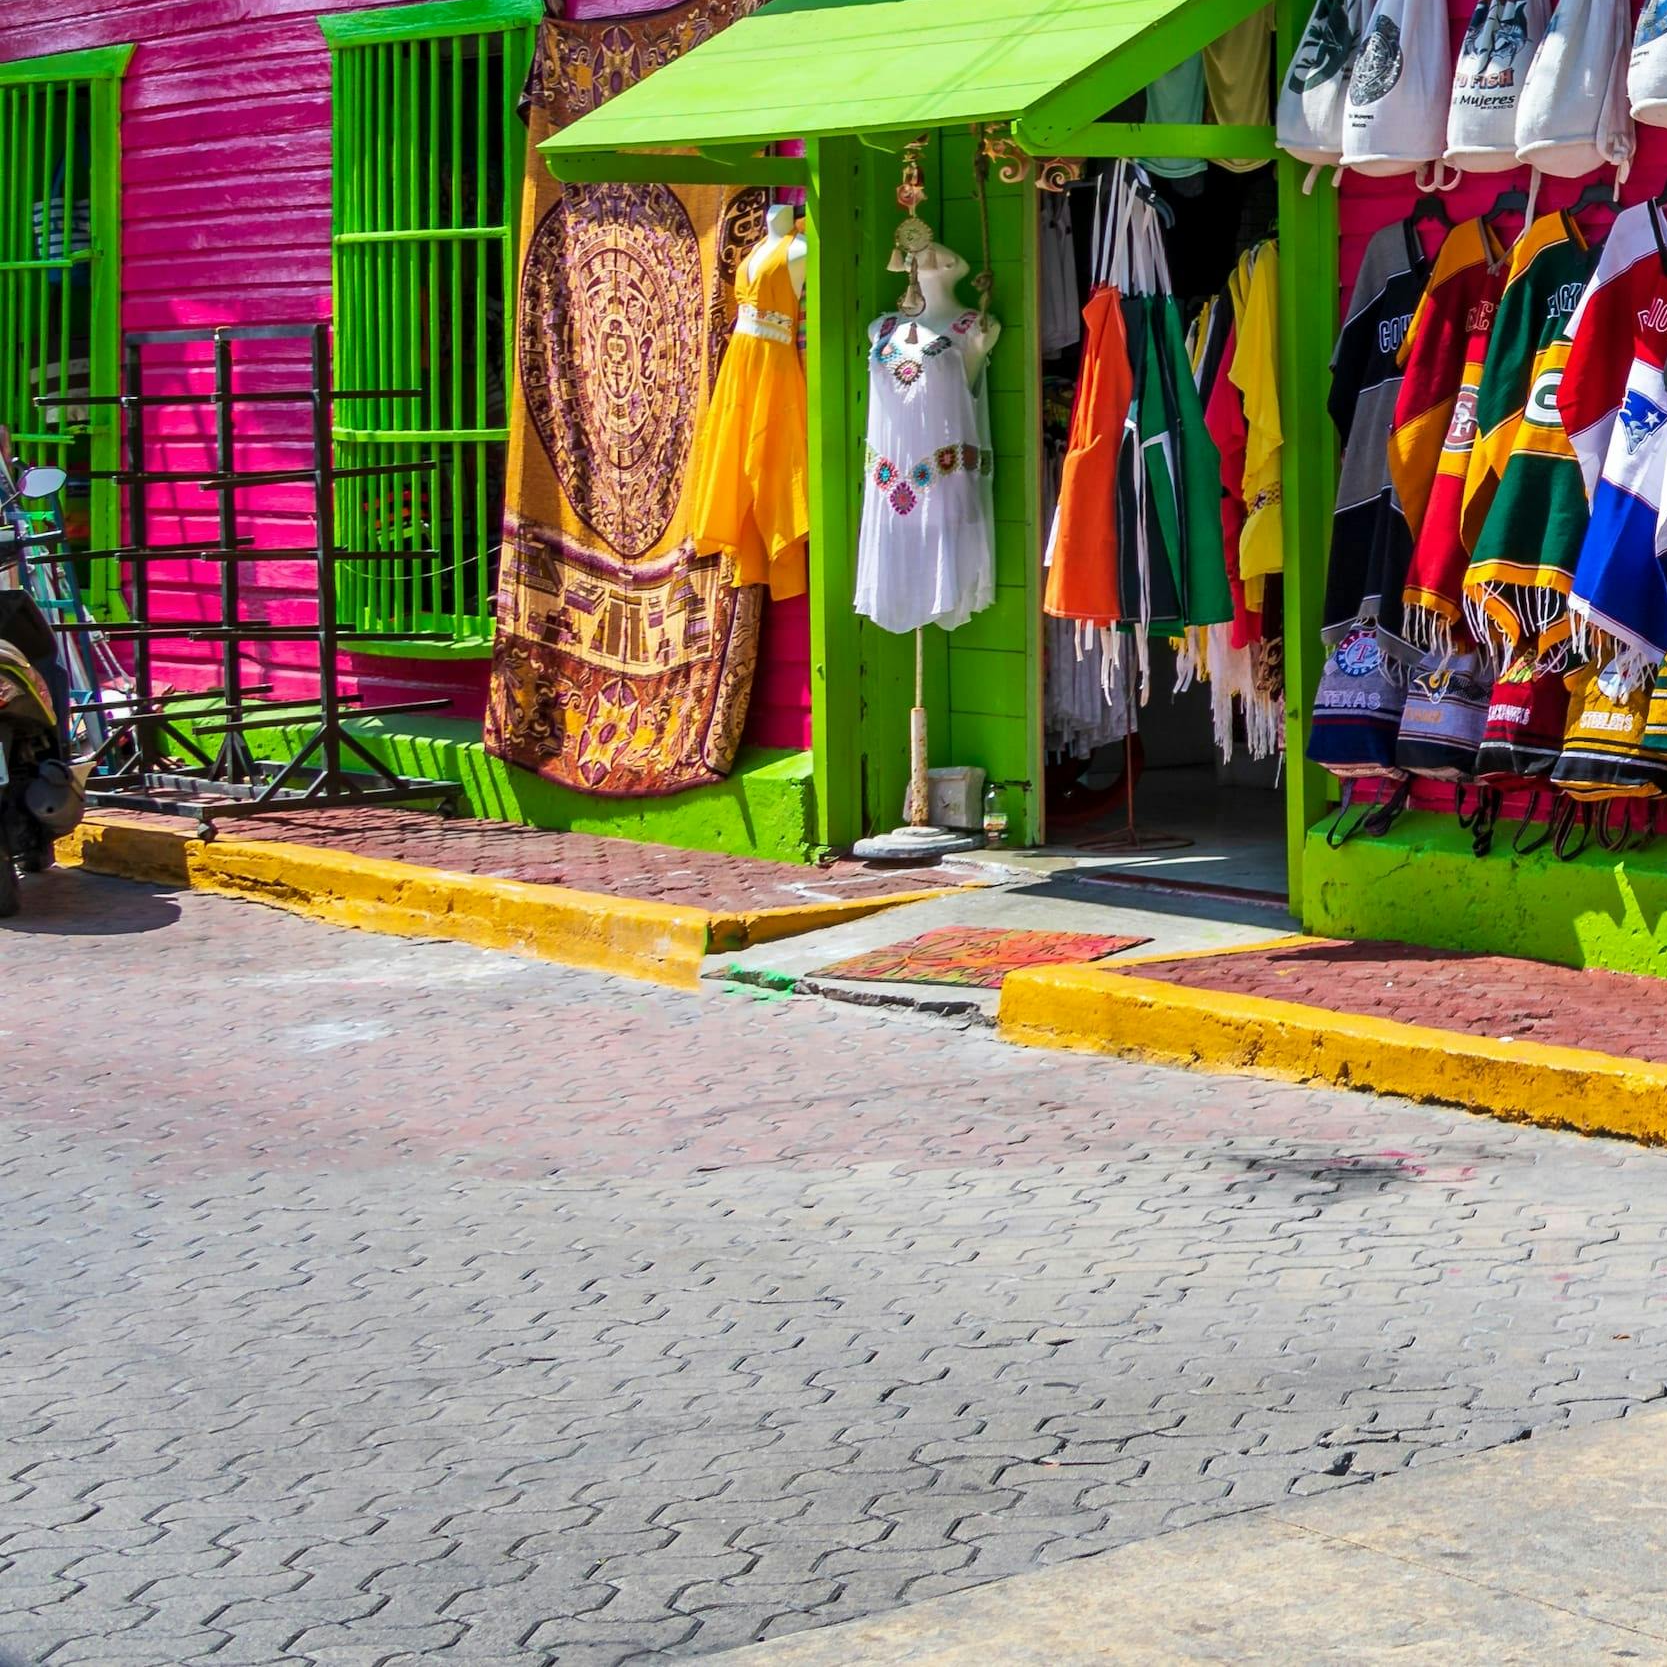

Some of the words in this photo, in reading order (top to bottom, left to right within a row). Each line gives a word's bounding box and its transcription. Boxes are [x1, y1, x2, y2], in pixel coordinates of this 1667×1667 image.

[1470, 67, 1515, 89] FISH
[1460, 95, 1515, 107] Mujeres
[1322, 690, 1381, 711] TEXAS
[1580, 711, 1634, 732] STEELERS
